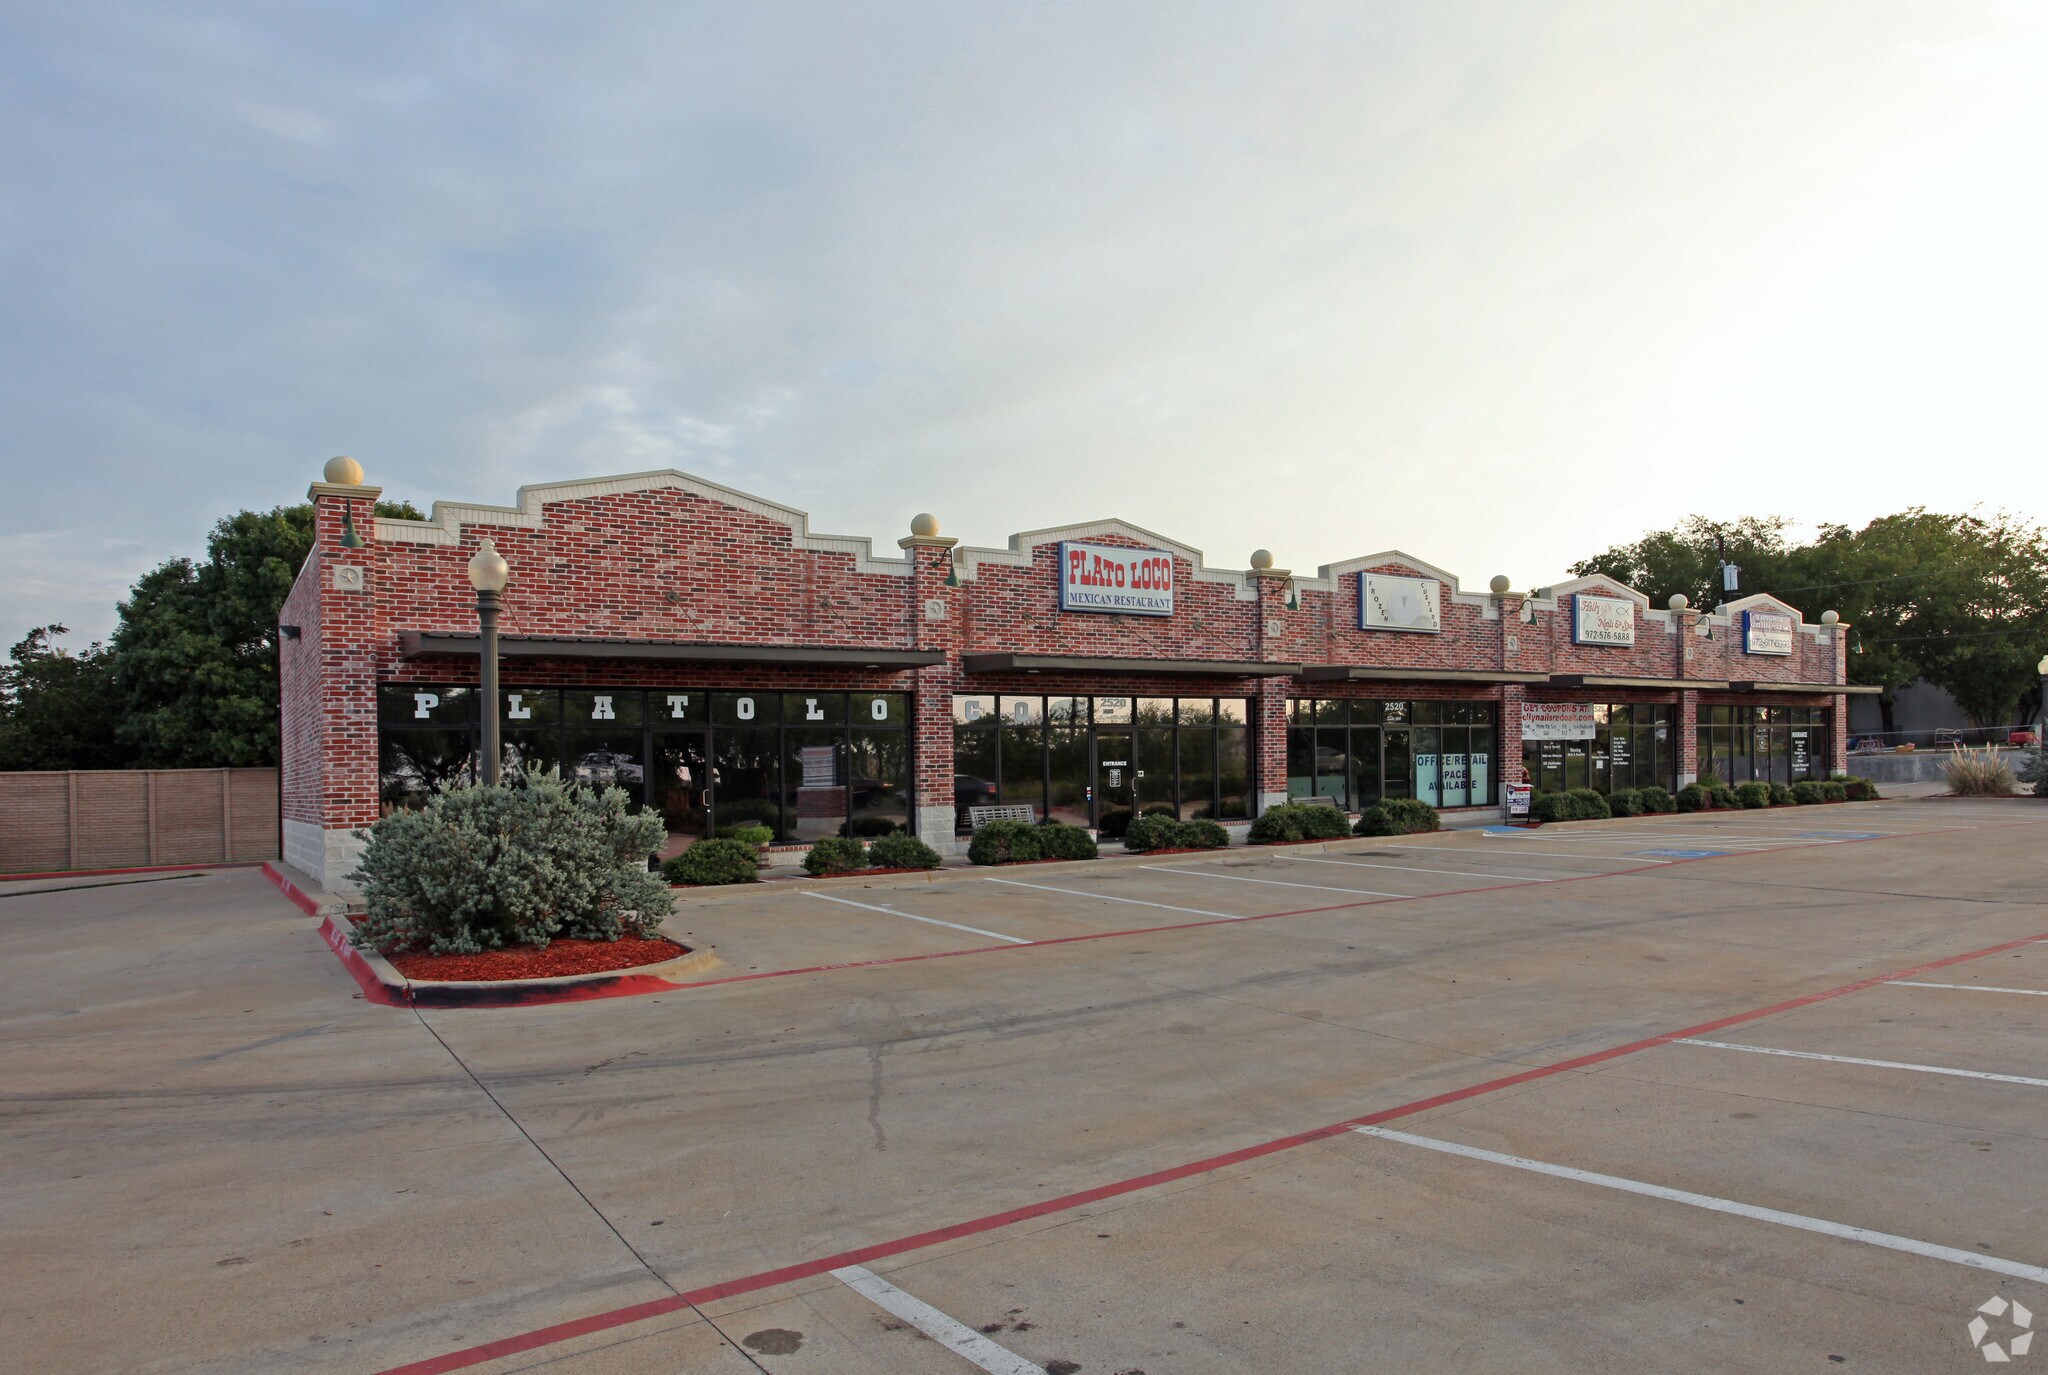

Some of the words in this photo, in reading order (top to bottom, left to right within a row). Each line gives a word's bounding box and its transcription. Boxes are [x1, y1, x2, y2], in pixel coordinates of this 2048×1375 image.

[1069, 550, 1125, 588] PLATO
[1131, 557, 1171, 591] LOCO
[1070, 593, 1113, 605] MEXICAN
[1114, 595, 1171, 609] RESTAURANT
[1369, 580, 1389, 622] FROZEN
[1420, 582, 1438, 628] CUSTARD
[1581, 600, 1600, 614] Holly
[1585, 630, 1630, 641] 972-576-5888
[1101, 698, 1127, 708] 2520
[1385, 702, 1404, 711] 2520
[1523, 703, 1539, 712] GET
[1540, 704, 1577, 713] COUPONS
[1522, 713, 1594, 723] ollynailsredoak.com
[1417, 755, 1487, 766] OFFIE/REAIL
[1441, 770, 1467, 779] PACE
[1428, 780, 1477, 791] AVAILABE
